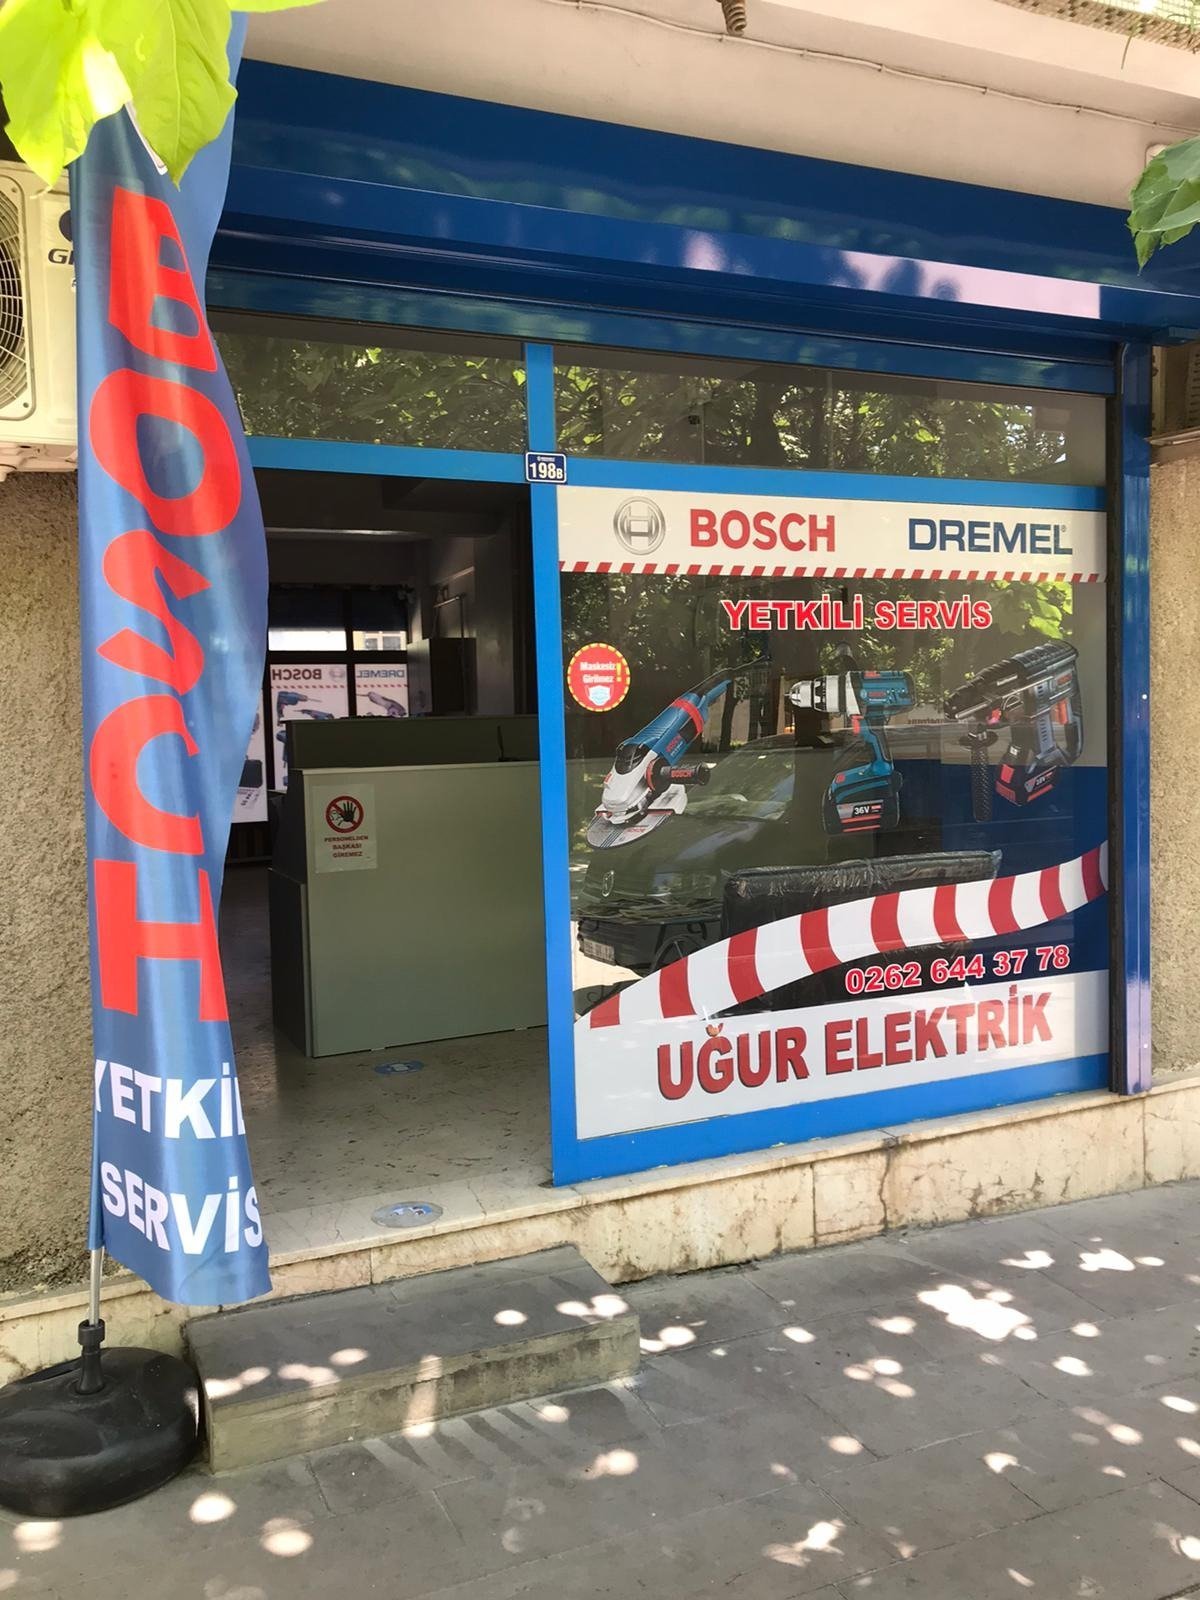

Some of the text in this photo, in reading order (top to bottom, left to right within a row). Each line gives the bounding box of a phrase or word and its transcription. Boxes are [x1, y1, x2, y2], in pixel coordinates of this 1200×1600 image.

[689, 508, 836, 552] BOSCH
[90, 187, 242, 1022] BOSCH
[721, 593, 993, 630] YETKİLİ SERVİS
[844, 944, 1071, 995] 0262 644 37 78
[656, 984, 1053, 1101] UĞUR ELEKTRİK
[101, 1161, 263, 1255] SERVİS
